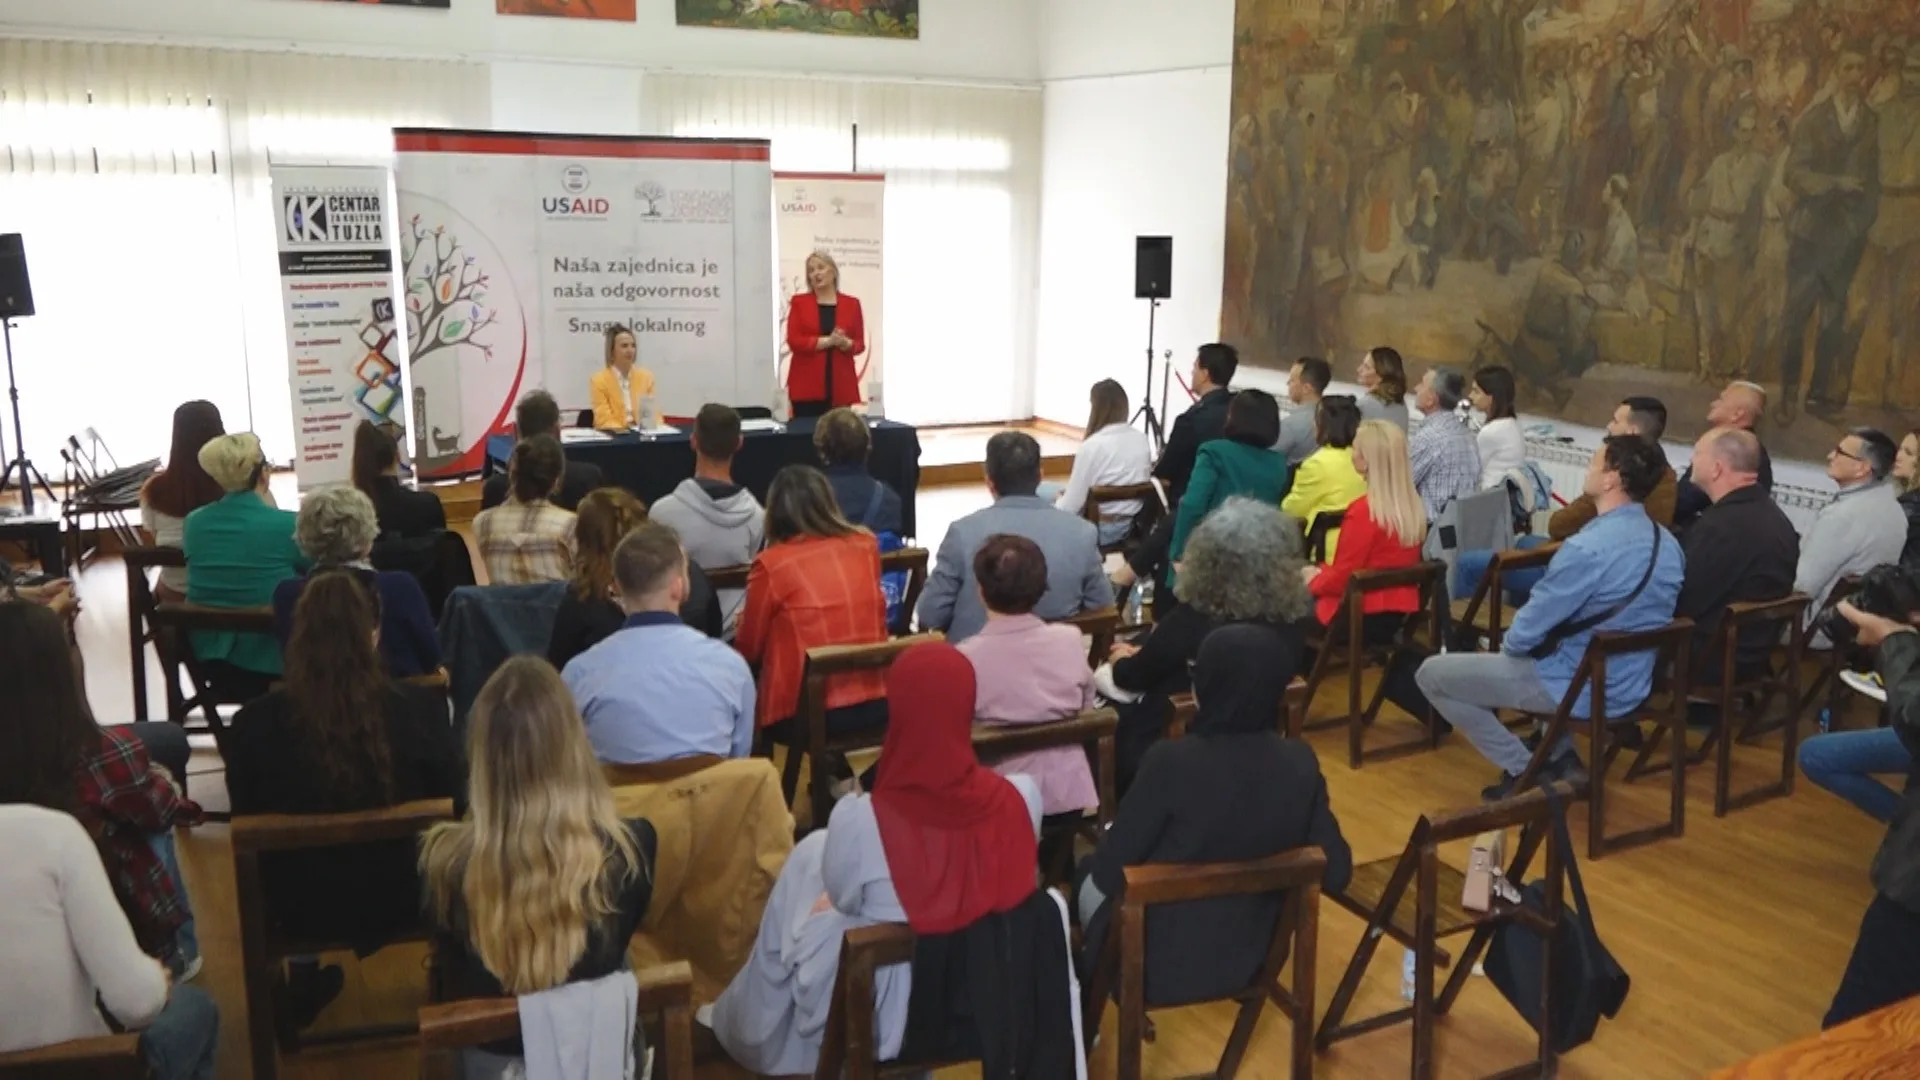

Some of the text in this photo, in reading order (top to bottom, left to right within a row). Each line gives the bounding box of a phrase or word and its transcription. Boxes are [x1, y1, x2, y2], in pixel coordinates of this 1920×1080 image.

[329, 196, 380, 212] CENTAR
[542, 197, 610, 214] USAID
[781, 203, 816, 212] USAID
[331, 225, 382, 240] TUZLA
[553, 257, 719, 277] Naša zajednica je
[553, 282, 720, 301] naša odgovornost
[629, 317, 705, 337] lokalnog
